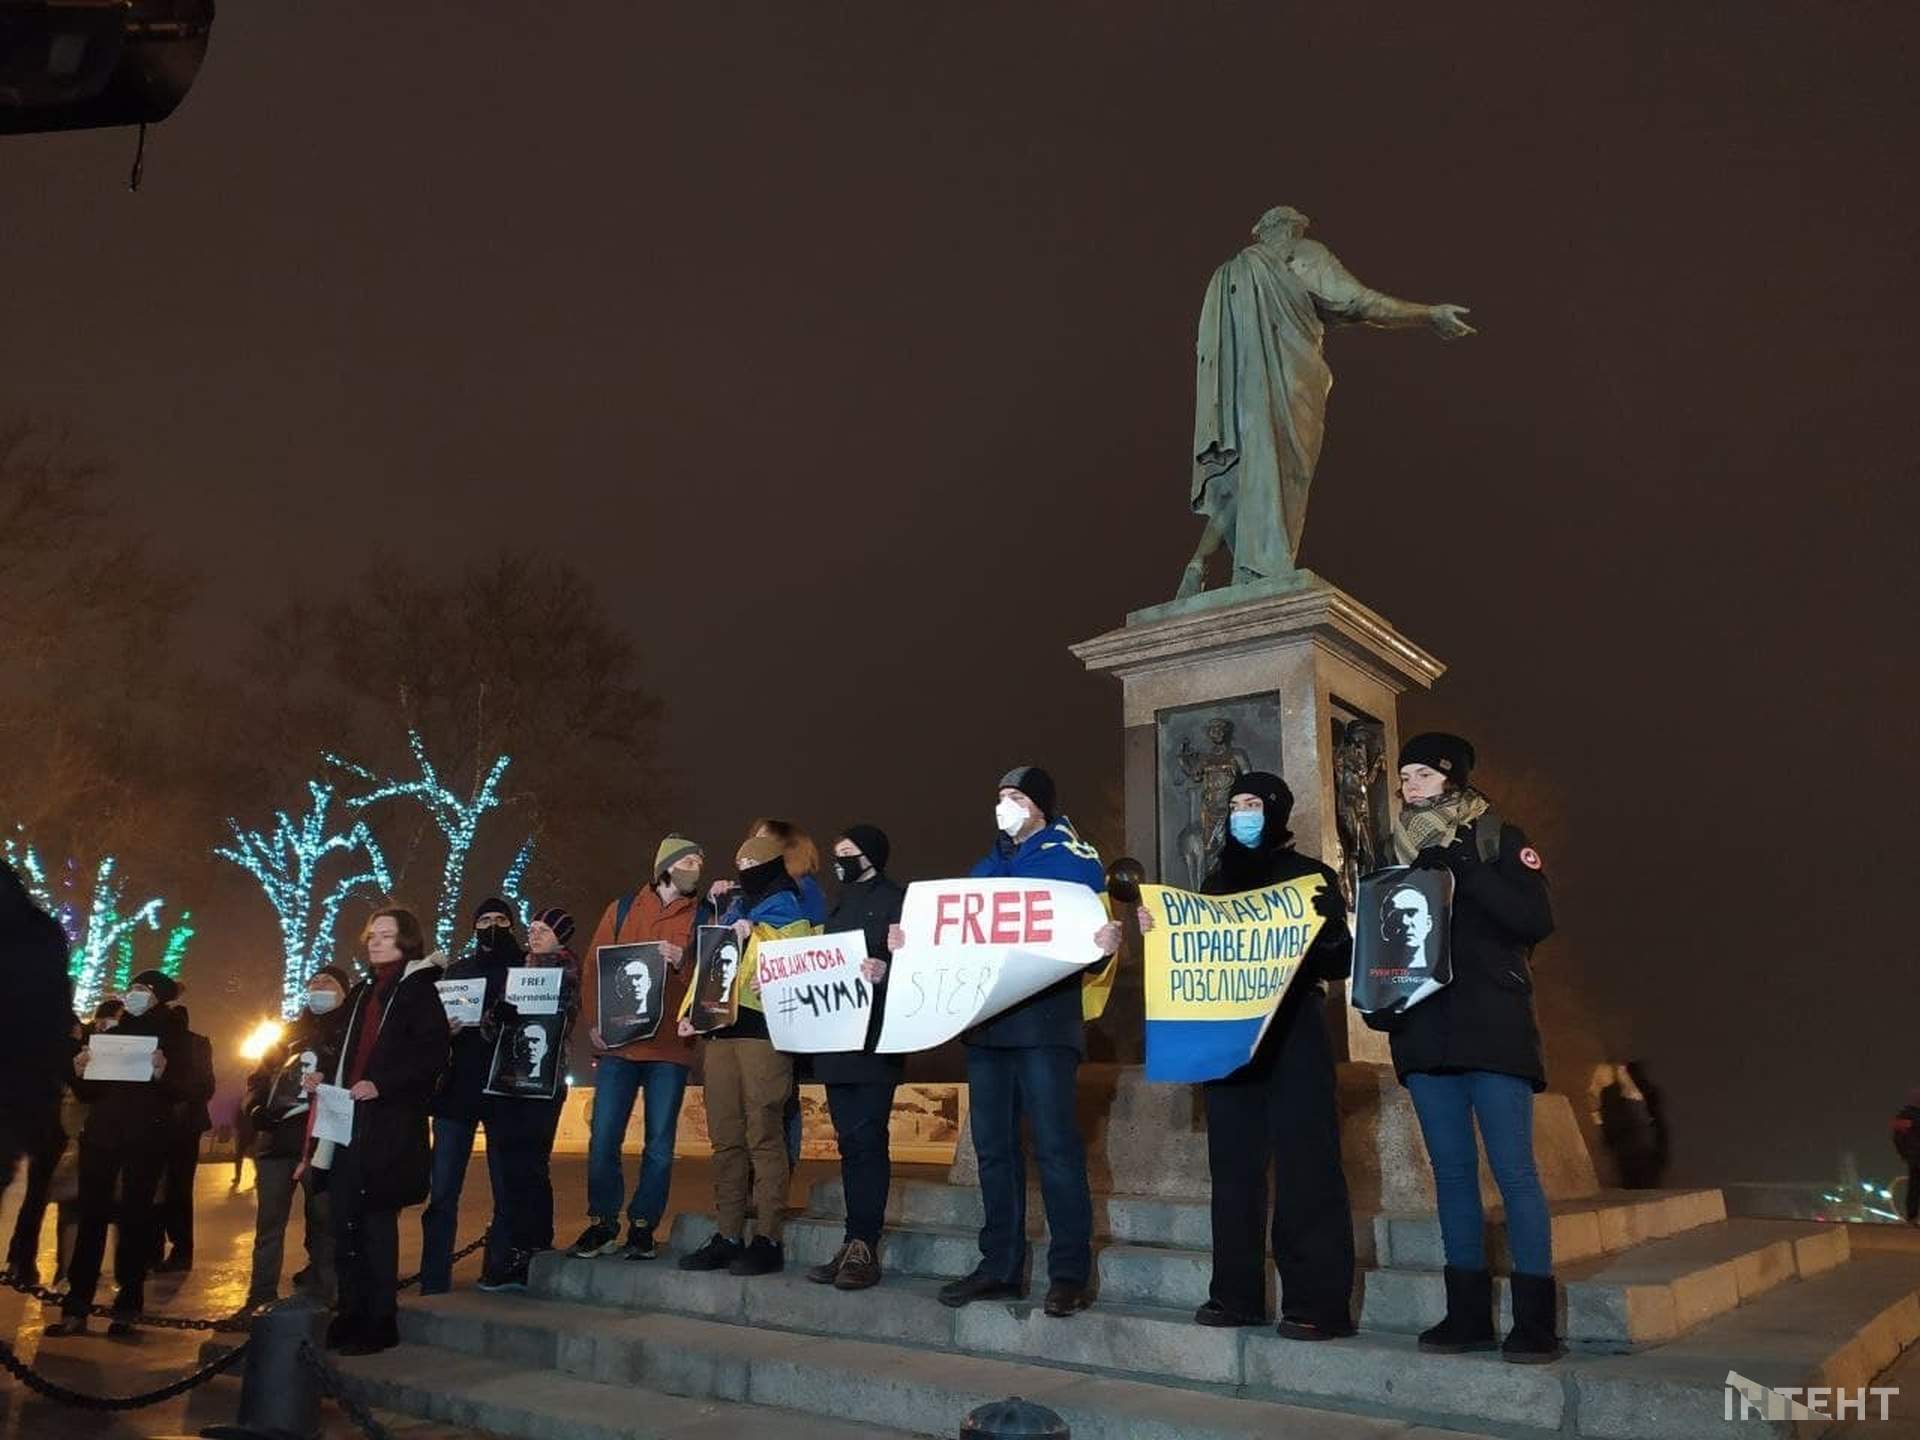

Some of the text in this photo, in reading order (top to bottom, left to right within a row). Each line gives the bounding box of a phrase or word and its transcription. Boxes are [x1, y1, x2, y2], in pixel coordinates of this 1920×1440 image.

[934, 890, 1054, 946] FREE
[1162, 886, 1304, 926] ВИМАГАЄМО
[778, 977, 869, 1024] #ЧУМА
